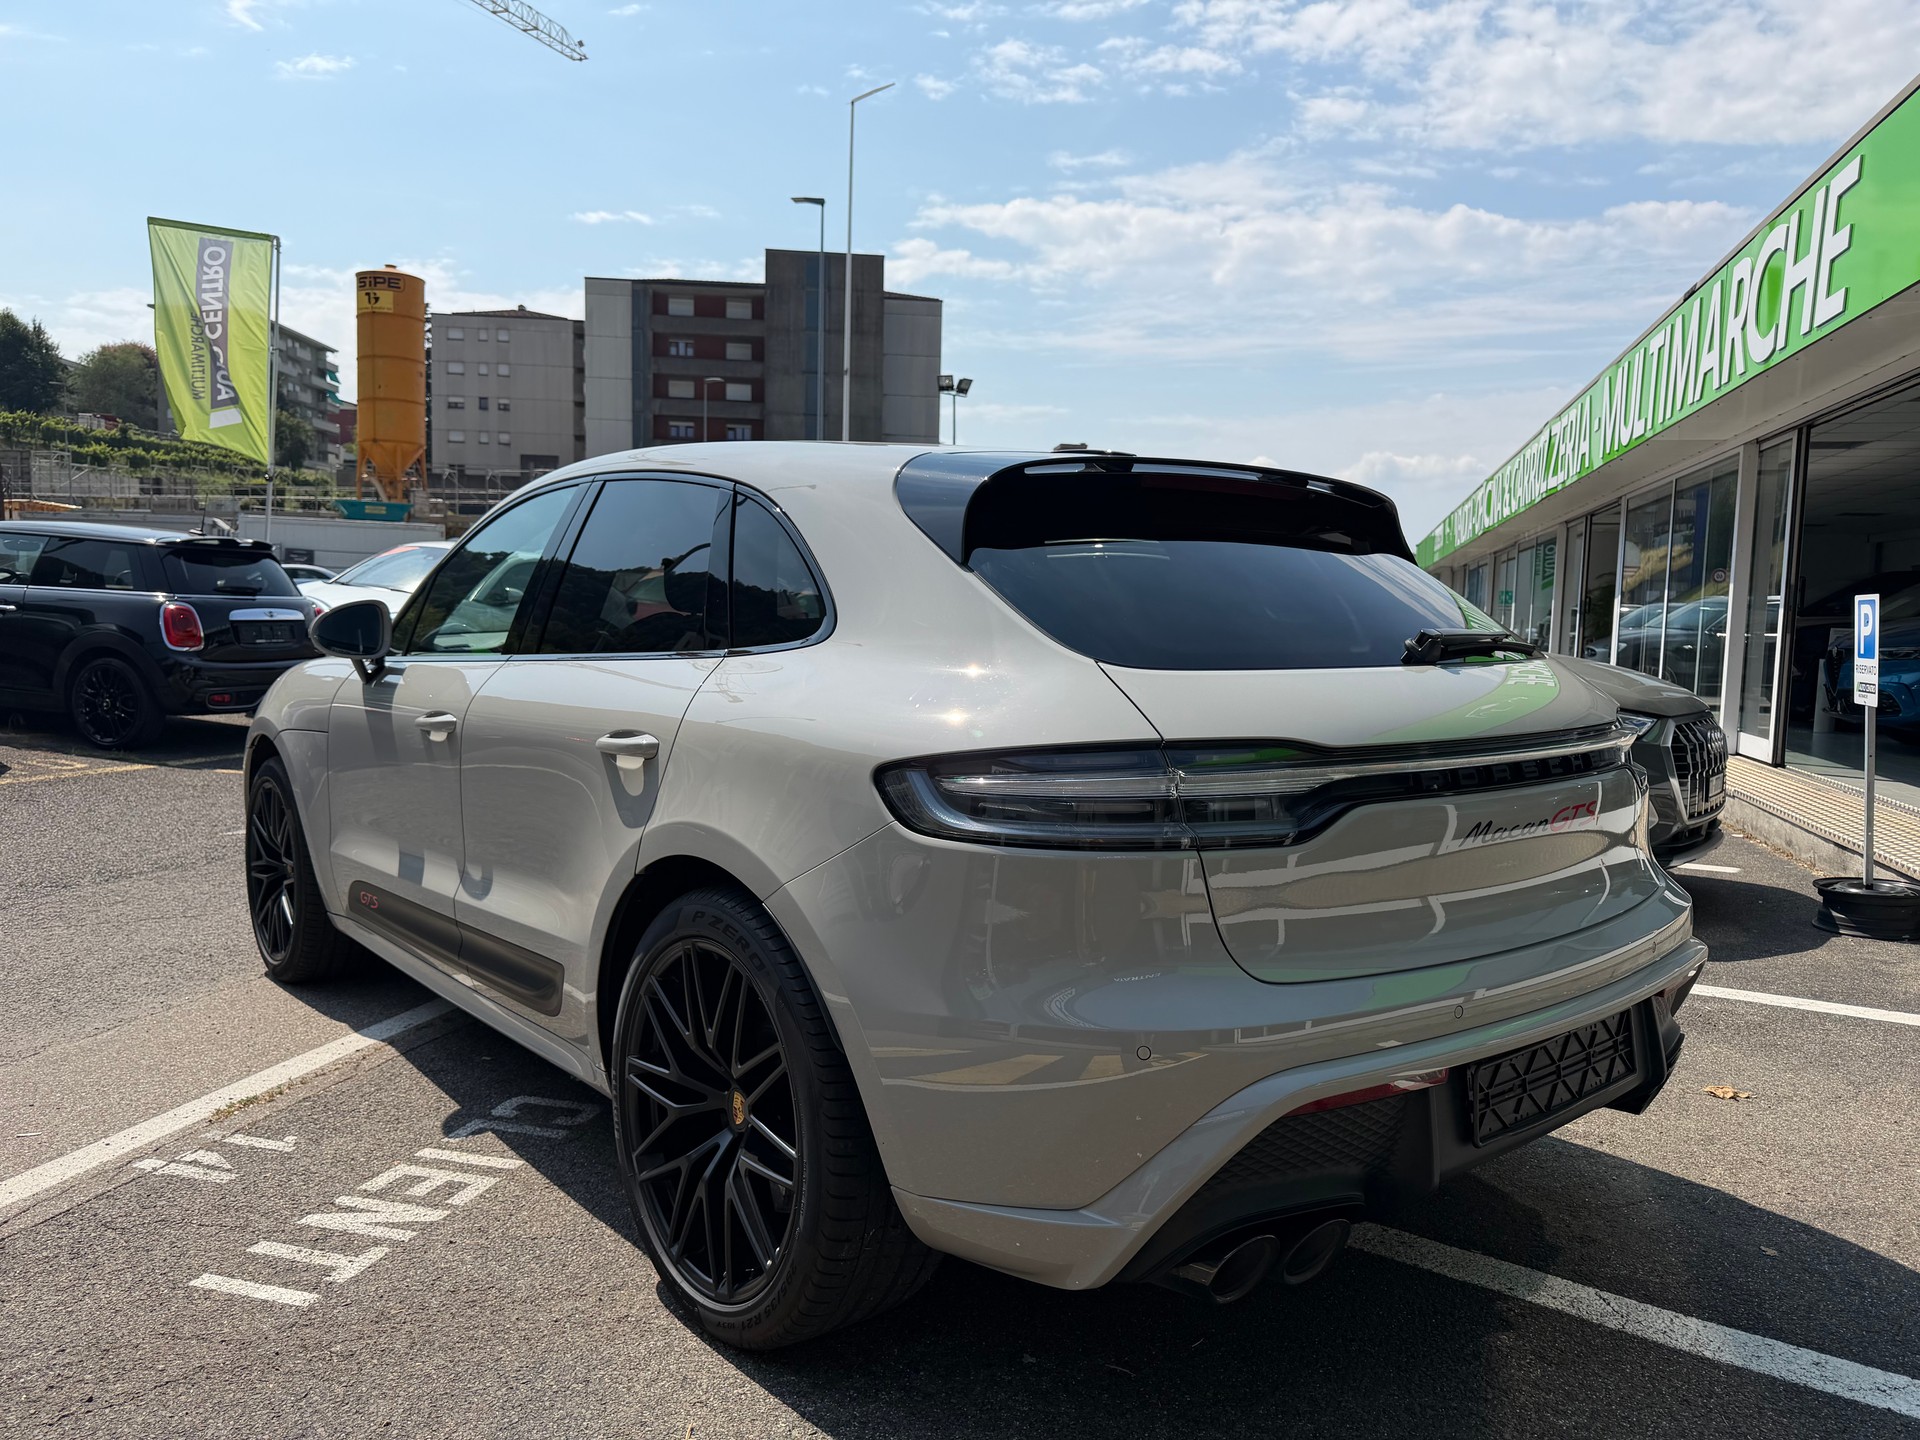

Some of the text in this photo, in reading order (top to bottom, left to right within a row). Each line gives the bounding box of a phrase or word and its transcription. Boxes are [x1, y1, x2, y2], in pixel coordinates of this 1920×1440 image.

[1601, 155, 1863, 460] MULTIMARCHE
[1860, 604, 1873, 655] P
[360, 891, 379, 909] GTS
[188, 1095, 600, 1307] CLIENTI
